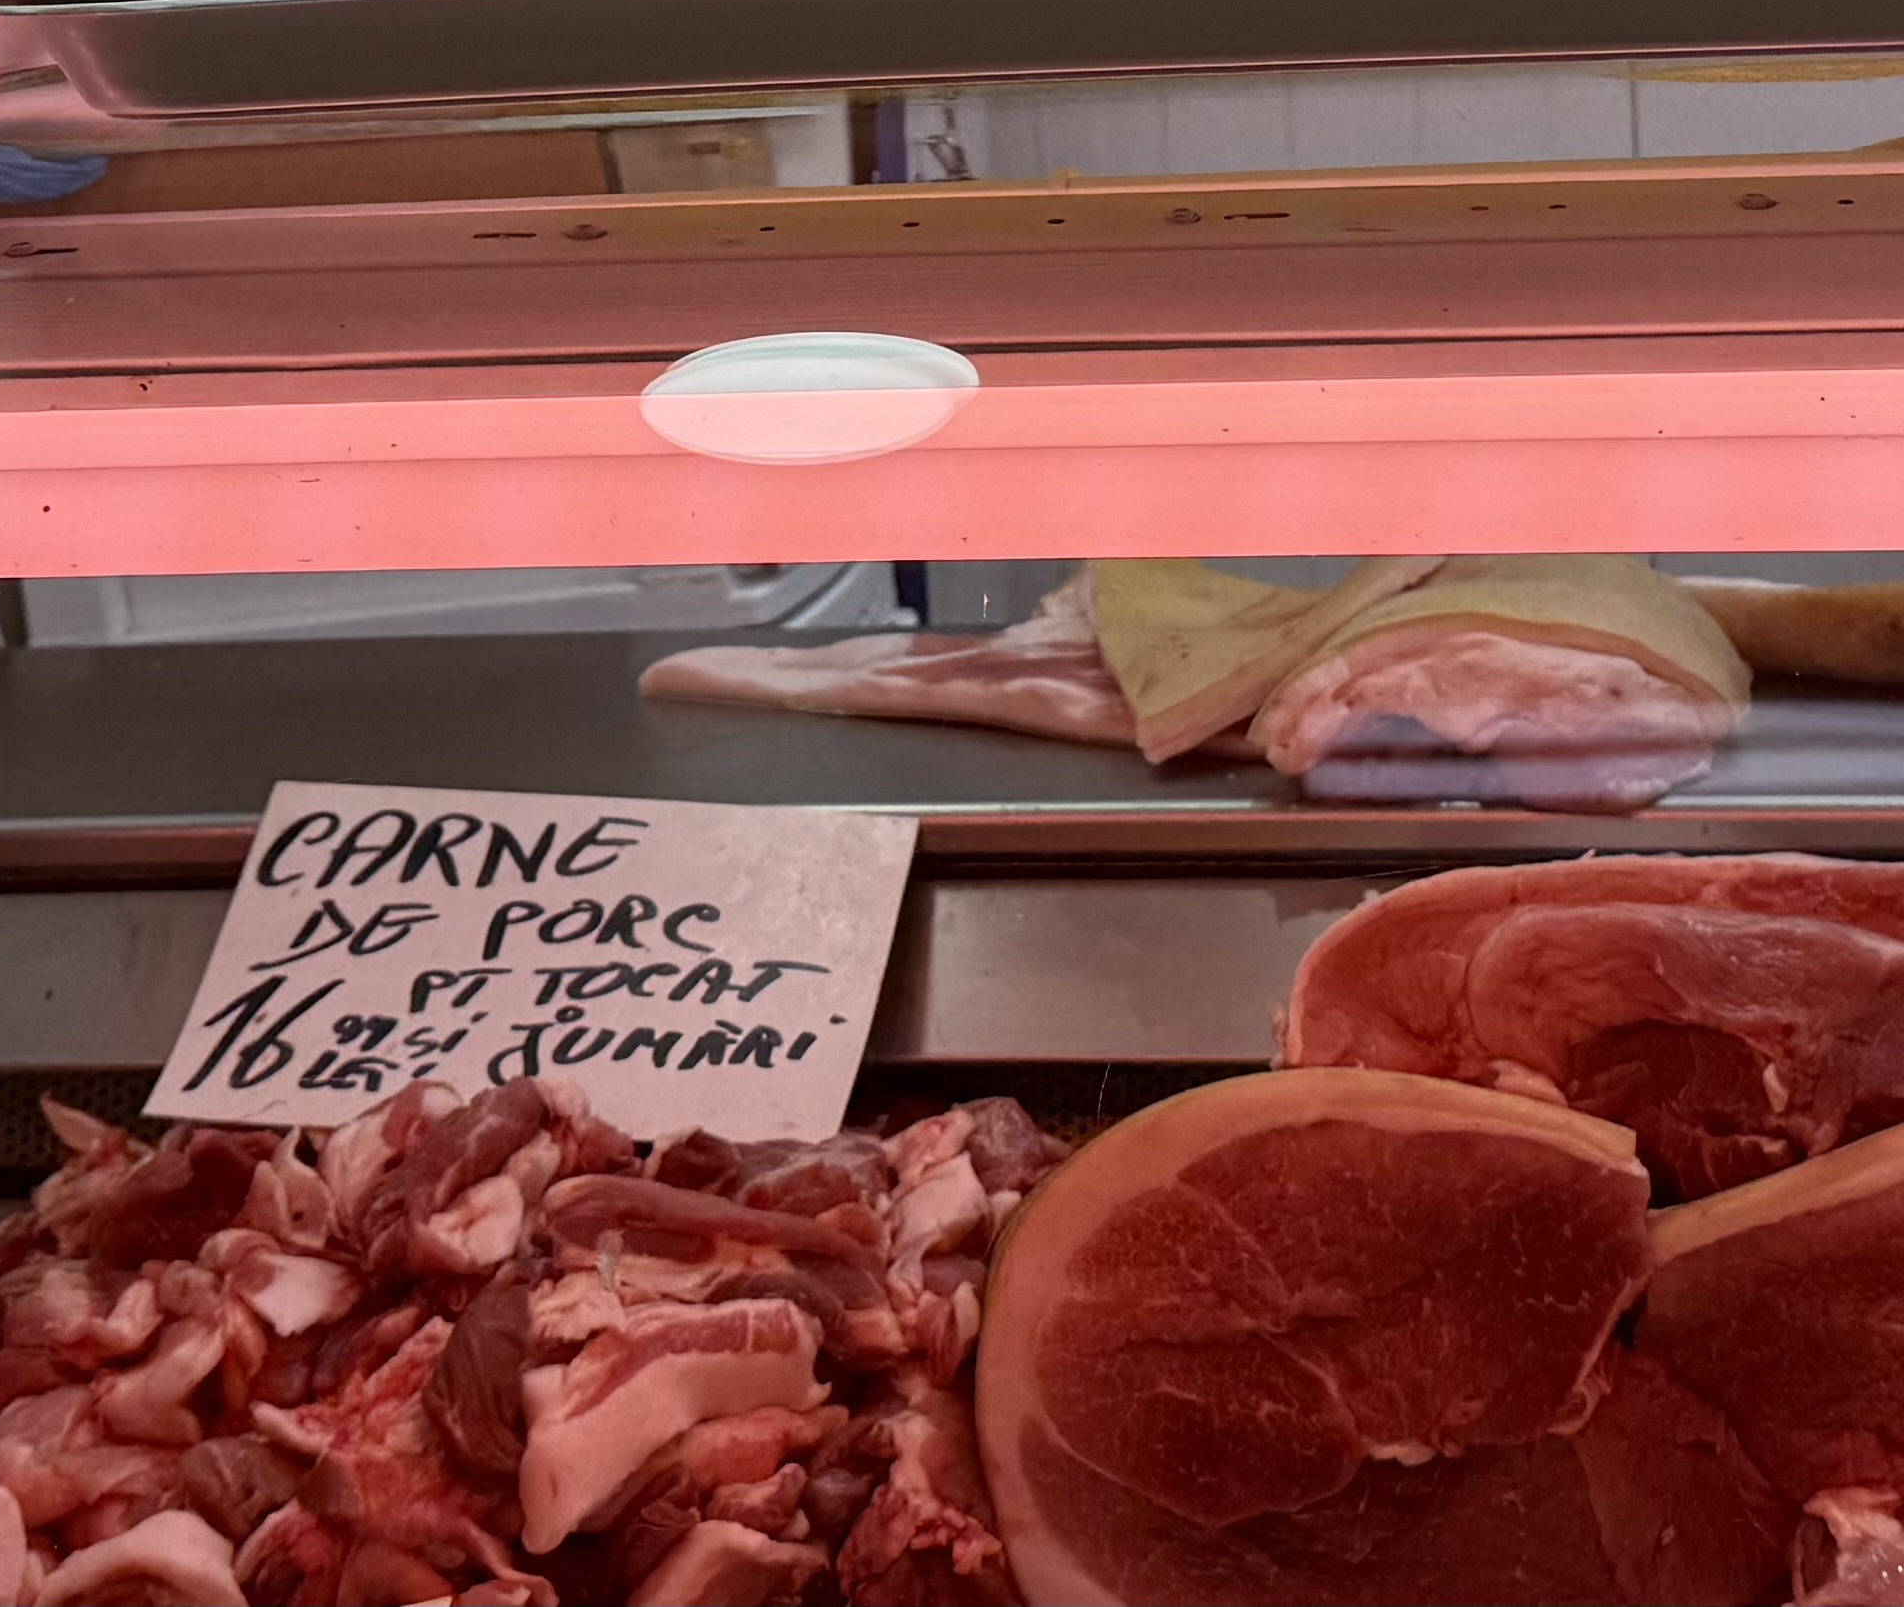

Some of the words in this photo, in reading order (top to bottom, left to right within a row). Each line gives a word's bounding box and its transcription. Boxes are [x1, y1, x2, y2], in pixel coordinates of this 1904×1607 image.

[256, 808, 650, 889] CARNE
[249, 900, 441, 971] DE
[484, 894, 721, 961] PORC
[534, 957, 832, 1005] TOCAT
[182, 974, 346, 1092] 16
